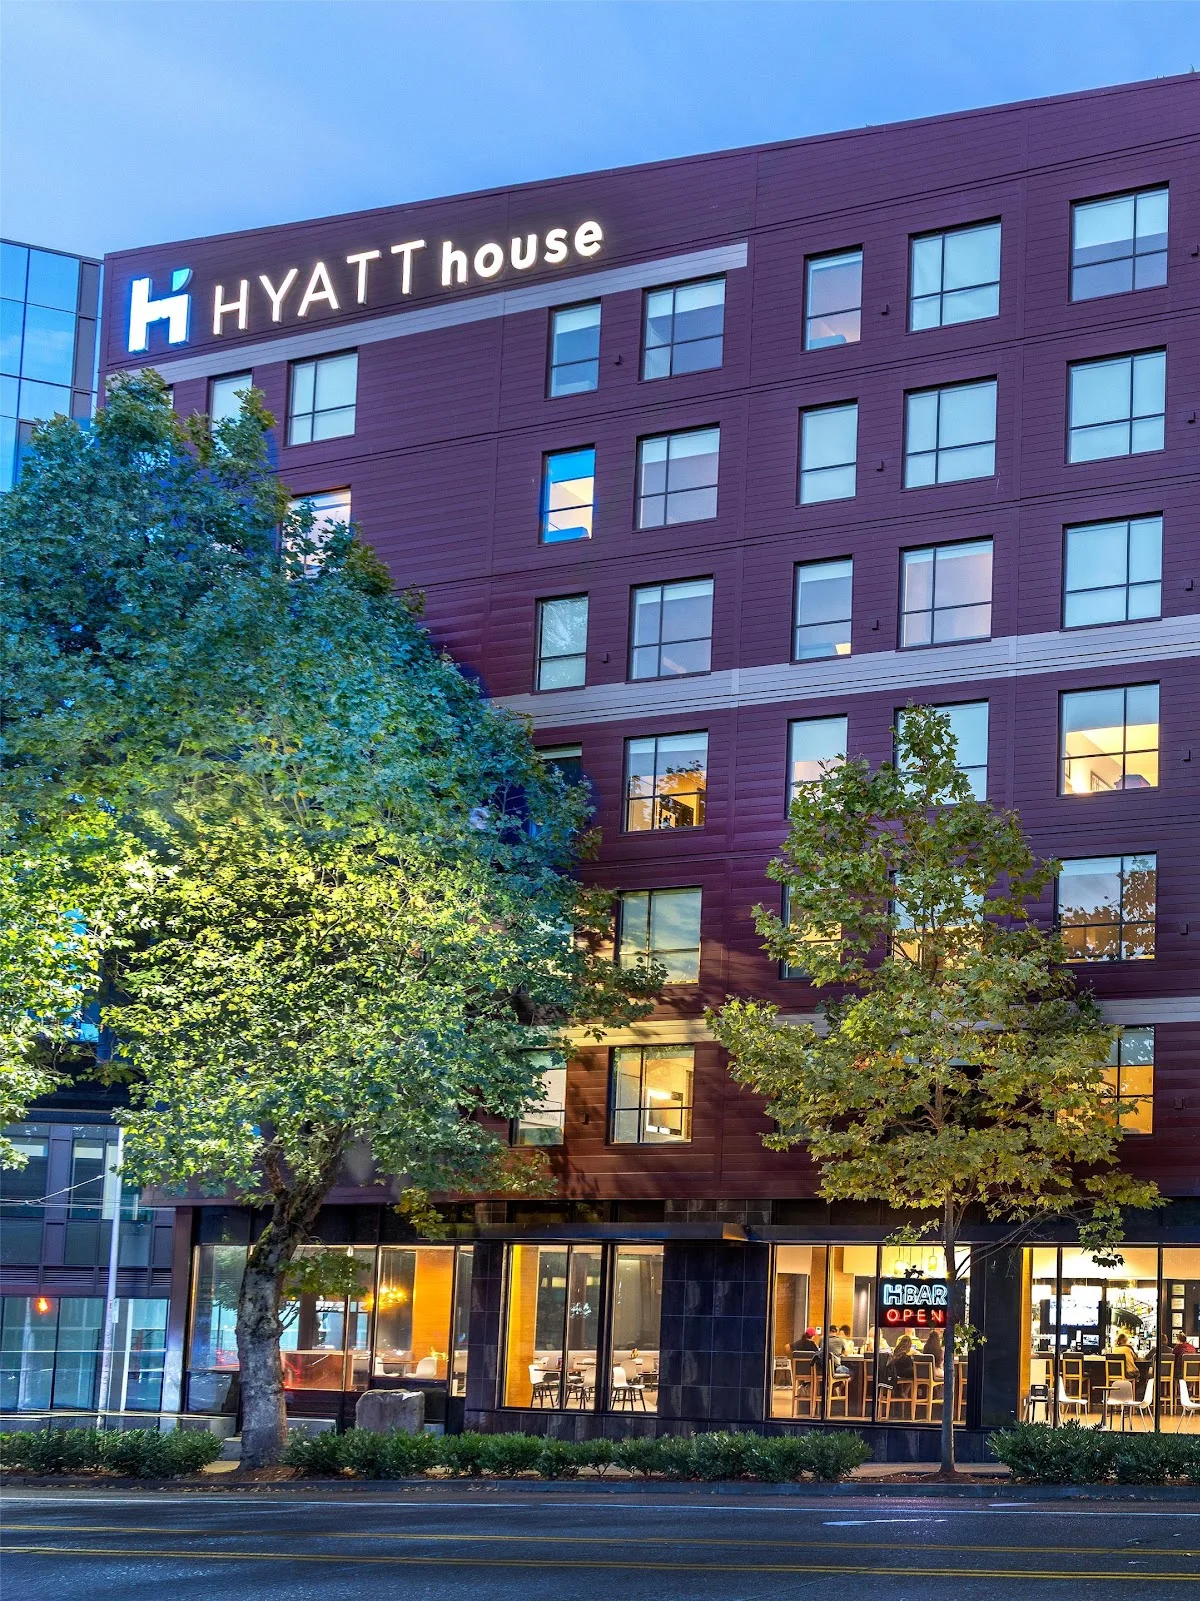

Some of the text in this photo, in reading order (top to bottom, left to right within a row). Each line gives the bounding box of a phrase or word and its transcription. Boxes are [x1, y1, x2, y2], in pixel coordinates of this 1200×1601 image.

[213, 239, 427, 336] HYATT
[442, 220, 604, 287] house
[887, 1309, 942, 1322] OPEN
